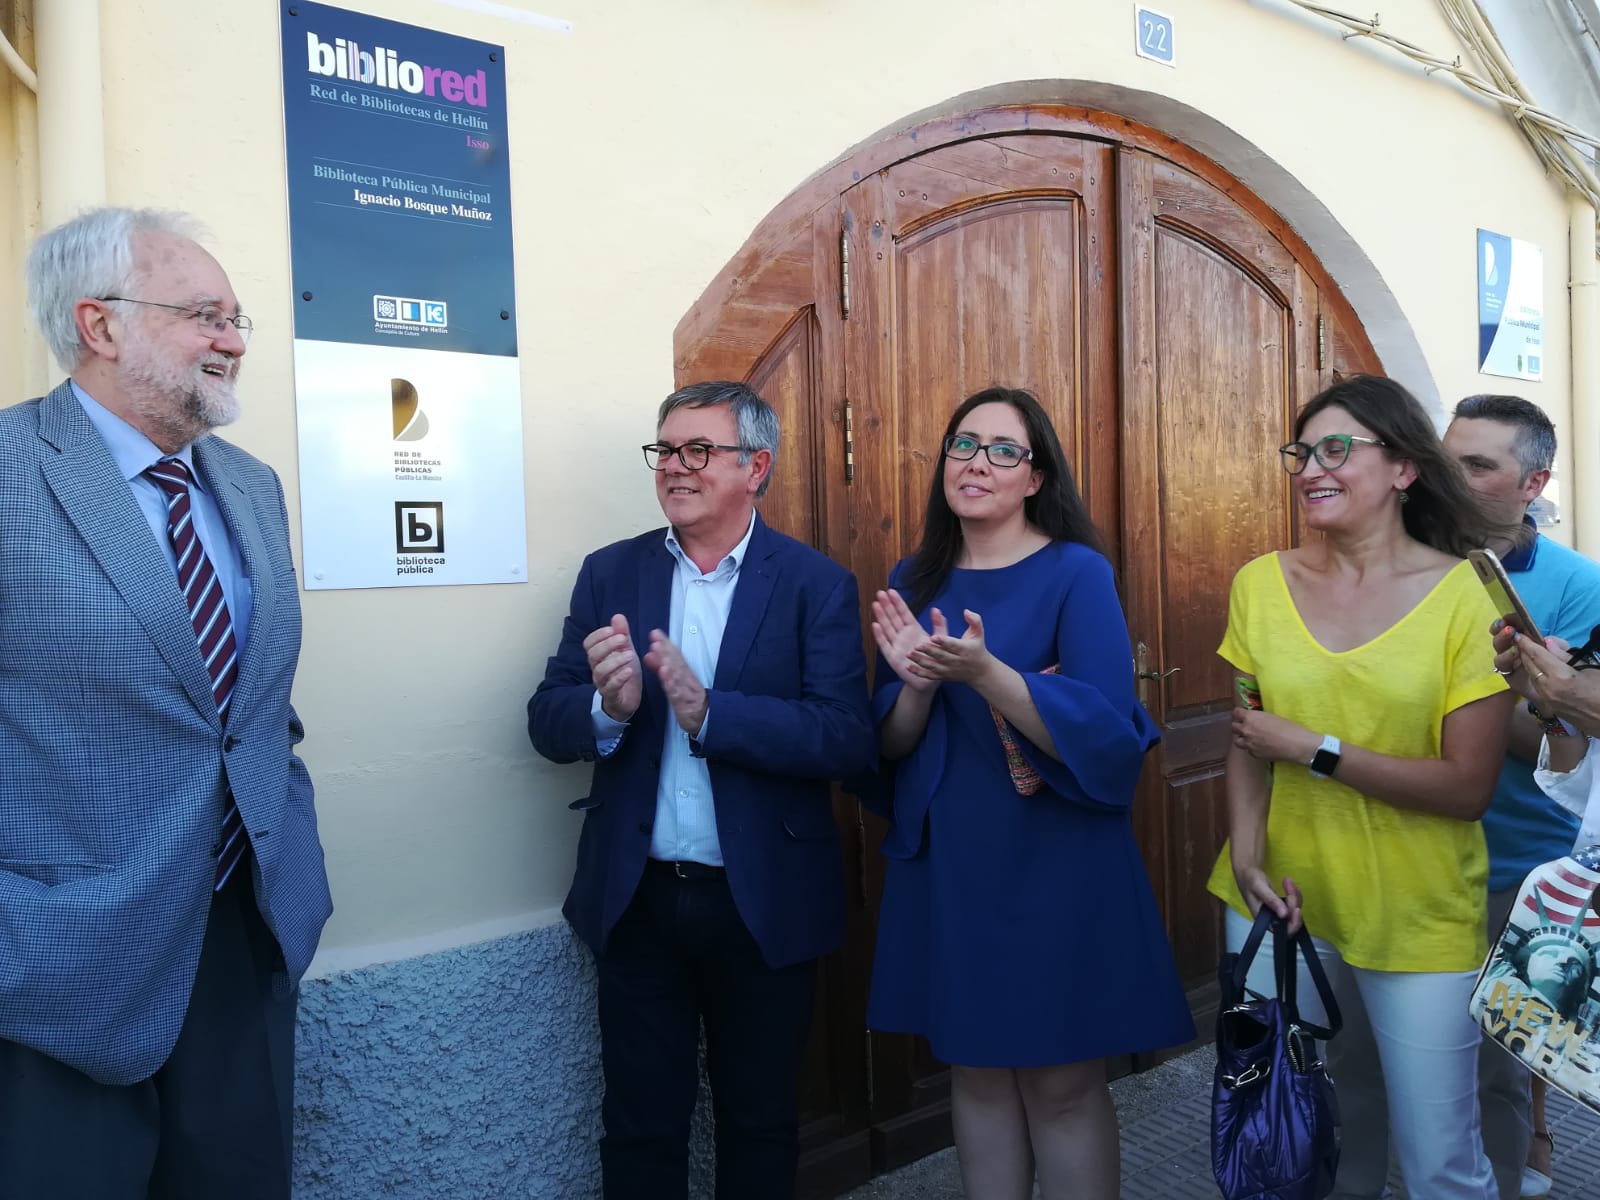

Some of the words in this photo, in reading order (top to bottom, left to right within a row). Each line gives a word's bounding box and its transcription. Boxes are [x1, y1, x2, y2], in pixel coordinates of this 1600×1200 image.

[1144, 20, 1166, 52] 22
[307, 31, 488, 107] bibliored
[310, 84, 337, 100] Red
[341, 92, 357, 105] de
[361, 94, 431, 119] Bibliotecas
[434, 110, 449, 122] de
[452, 112, 489, 130] Hellín
[466, 135, 490, 150] Isso
[313, 164, 378, 186] Biblioteca
[382, 174, 428, 194] Pública
[431, 184, 491, 204] Municipal
[354, 189, 401, 207] Ignacio
[404, 197, 448, 214] Bosque
[451, 204, 492, 221] Muñoz
[375, 322, 420, 332] Ayuntamiento
[394, 466, 432, 474] PÚBLICAS
[396, 556, 446, 566] biblioteca
[396, 565, 435, 576] pública
[1487, 981, 1592, 1060] NEW
